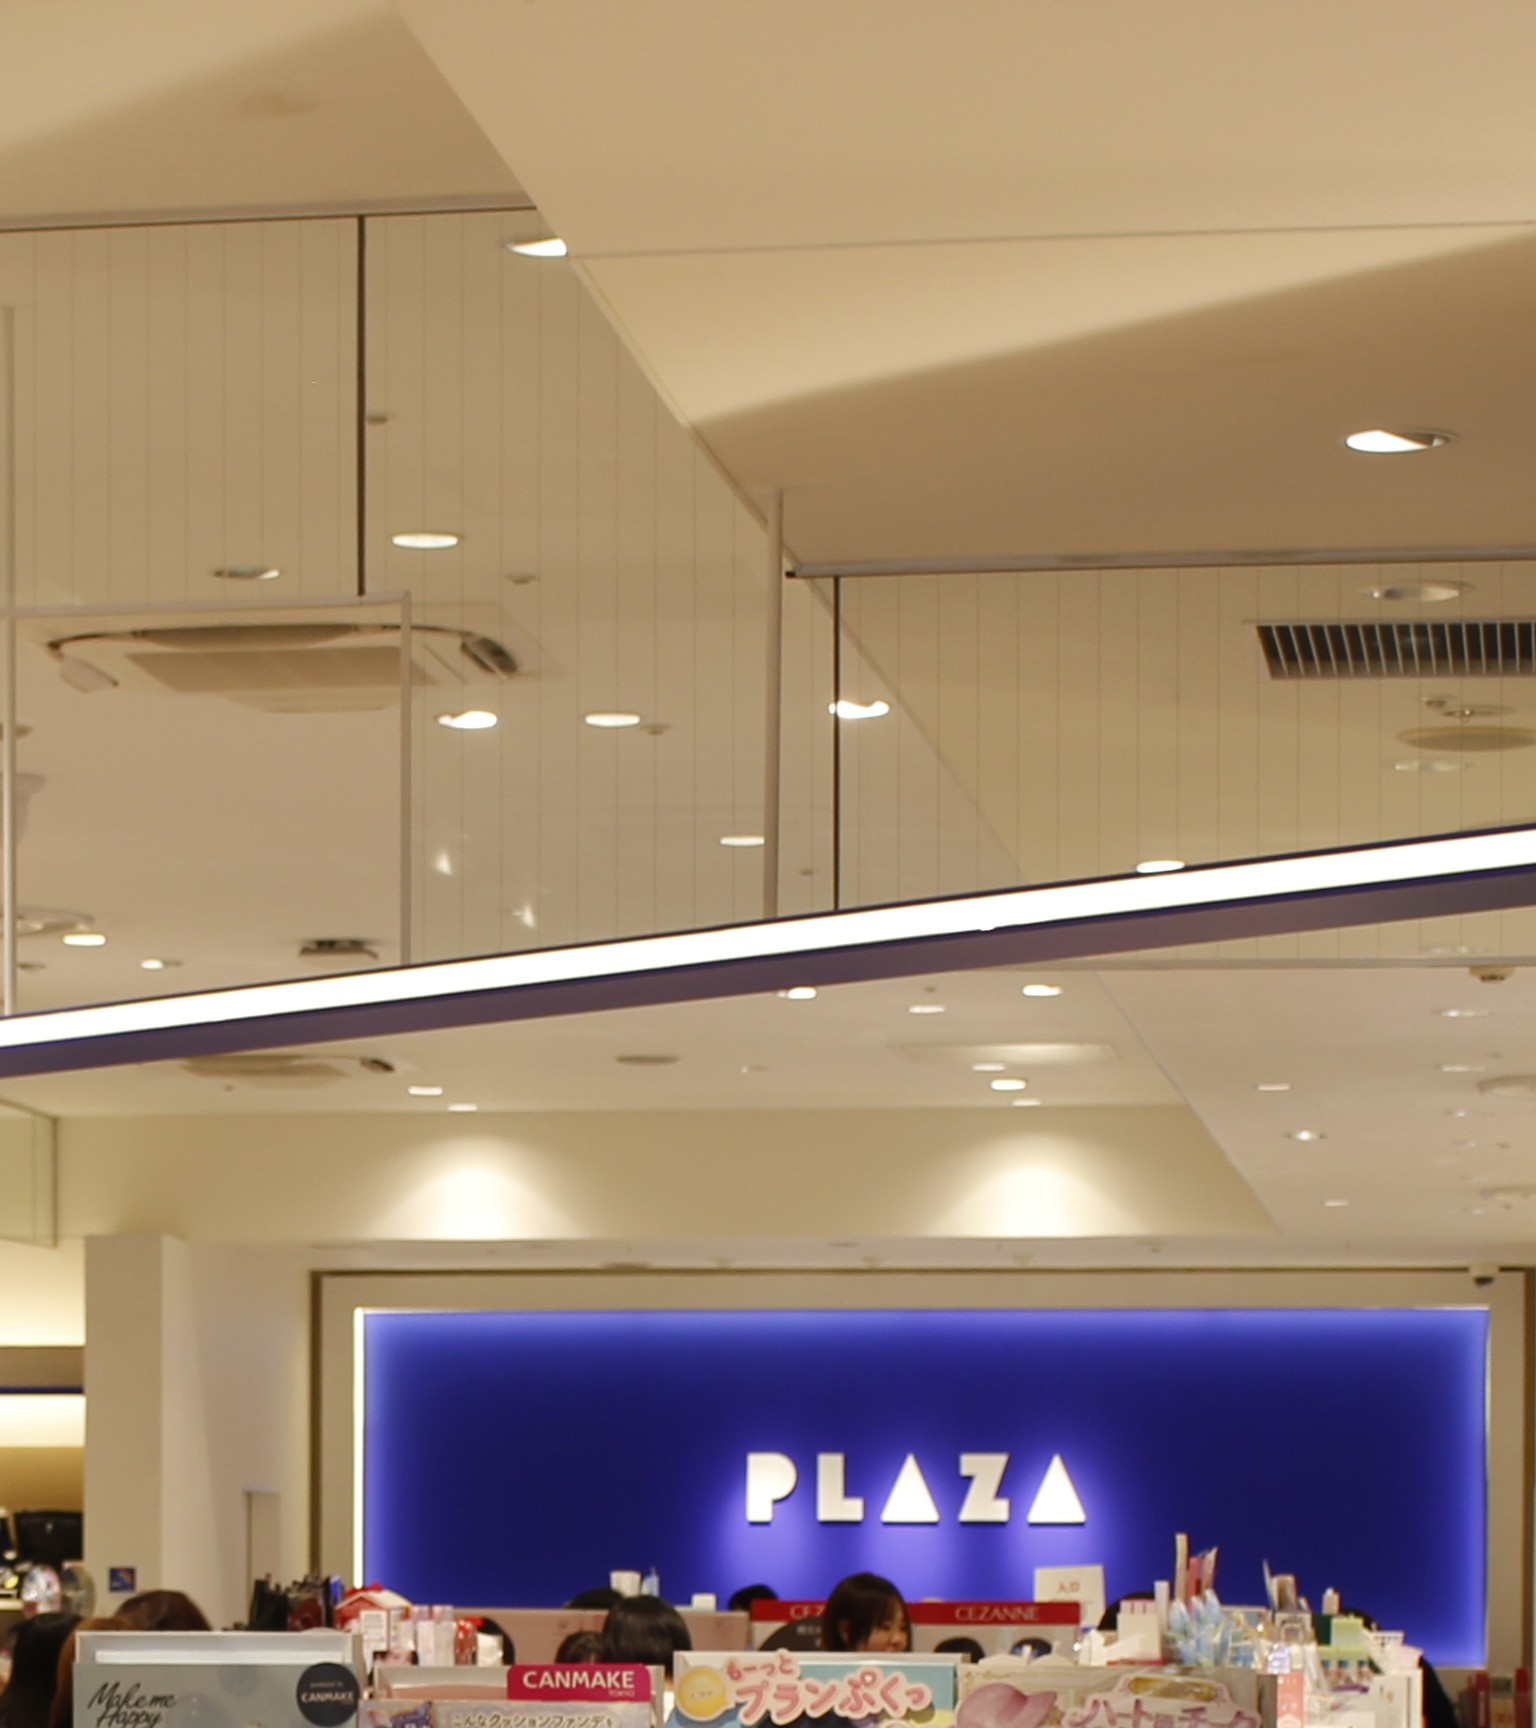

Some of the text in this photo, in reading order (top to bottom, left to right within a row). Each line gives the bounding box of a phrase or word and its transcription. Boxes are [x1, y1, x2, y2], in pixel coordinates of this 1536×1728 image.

[744, 1451, 1087, 1524] PLAZA
[954, 1606, 1040, 1621] CEZANNE
[522, 1671, 635, 1690] CANMAKE
[725, 1655, 795, 1681] もーっと
[87, 1681, 177, 1711] Make me
[300, 1693, 355, 1704] CANMAKE
[736, 1668, 928, 1720] プランぷくっ
